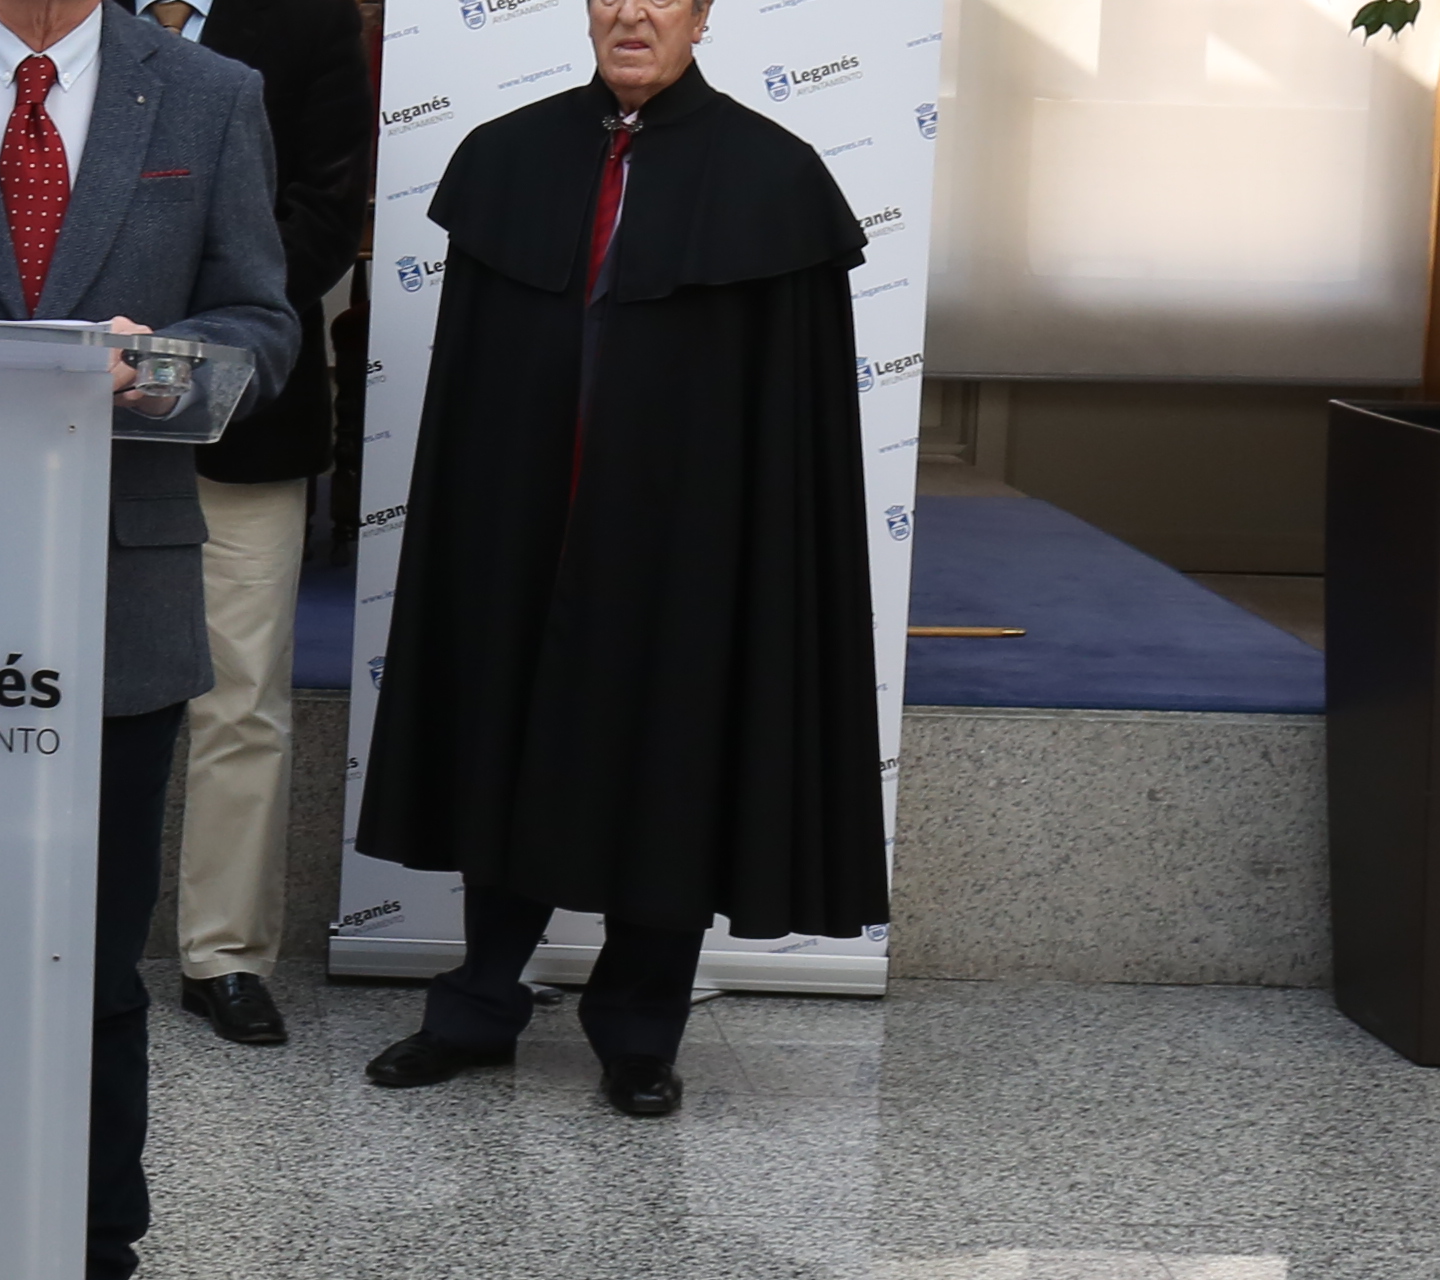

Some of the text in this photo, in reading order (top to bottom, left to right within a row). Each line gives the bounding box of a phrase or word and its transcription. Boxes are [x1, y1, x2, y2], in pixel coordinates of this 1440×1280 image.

[791, 55, 859, 85] Leganés
[382, 95, 451, 126] Leganés
[875, 352, 923, 376] Legan
